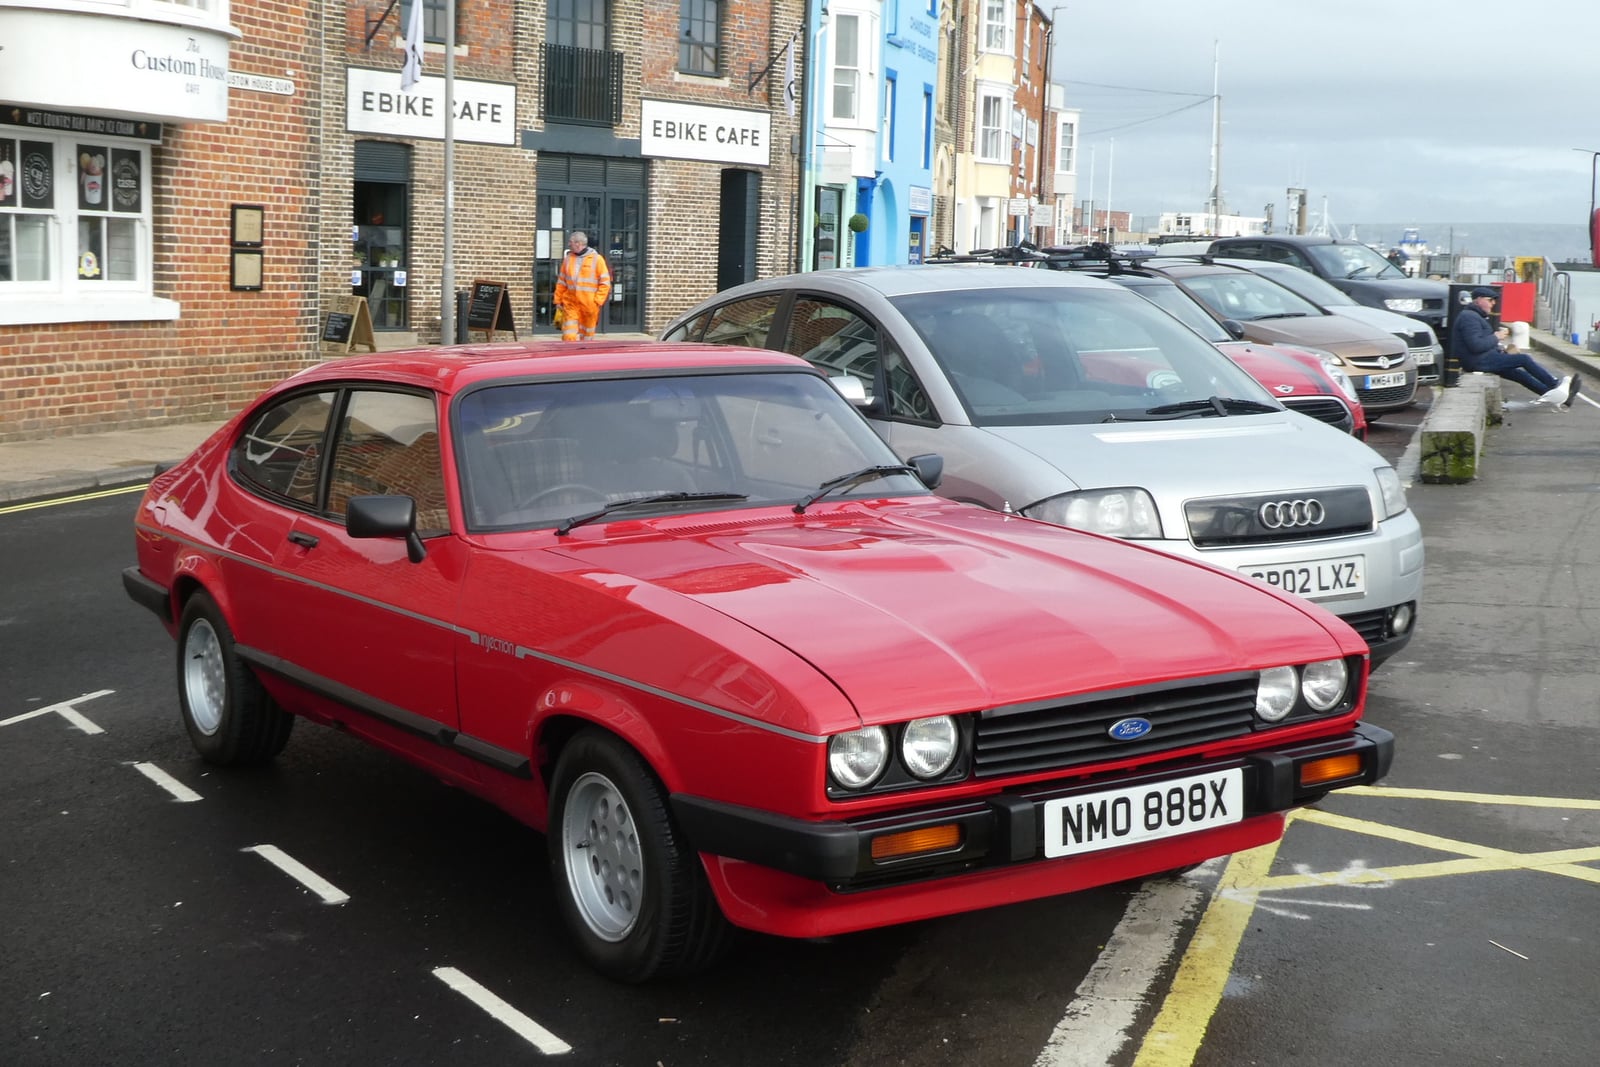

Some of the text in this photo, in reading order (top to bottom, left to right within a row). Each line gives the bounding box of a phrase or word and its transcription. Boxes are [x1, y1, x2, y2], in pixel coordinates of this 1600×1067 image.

[131, 49, 196, 76] Custom
[227, 75, 293, 94] USTOM HOUSE QUAY
[362, 91, 502, 123] EBIKE AFE
[653, 119, 760, 147] EBIKE CAFE
[1317, 562, 1357, 591] LXZ
[1119, 721, 1143, 735] Ford
[1061, 777, 1228, 846] NMO 888X
